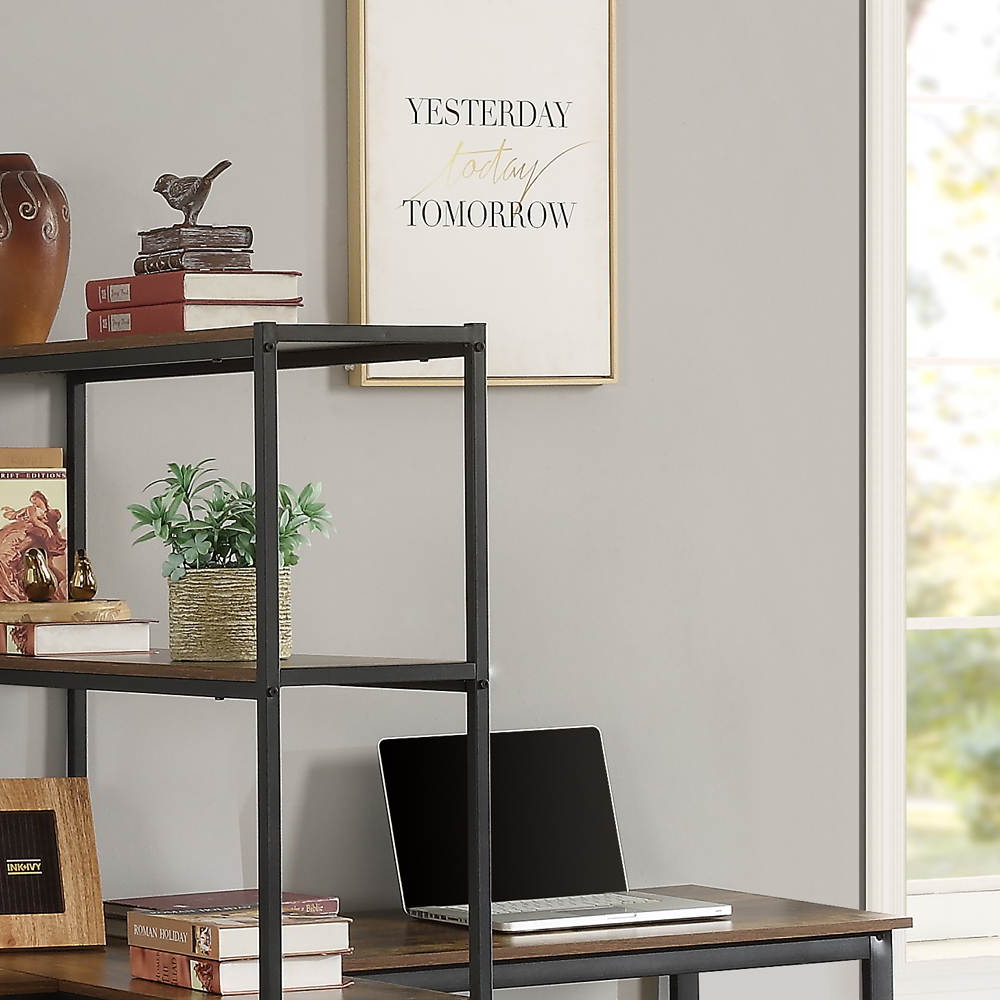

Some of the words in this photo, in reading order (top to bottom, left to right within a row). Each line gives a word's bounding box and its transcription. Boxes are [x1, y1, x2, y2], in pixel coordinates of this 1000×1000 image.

[405, 97, 573, 128] YESTERDAY
[404, 138, 590, 208] today
[402, 199, 577, 229] TOMORROW
[133, 924, 158, 938] ROMAN
[159, 928, 188, 943] HOLIDAY
